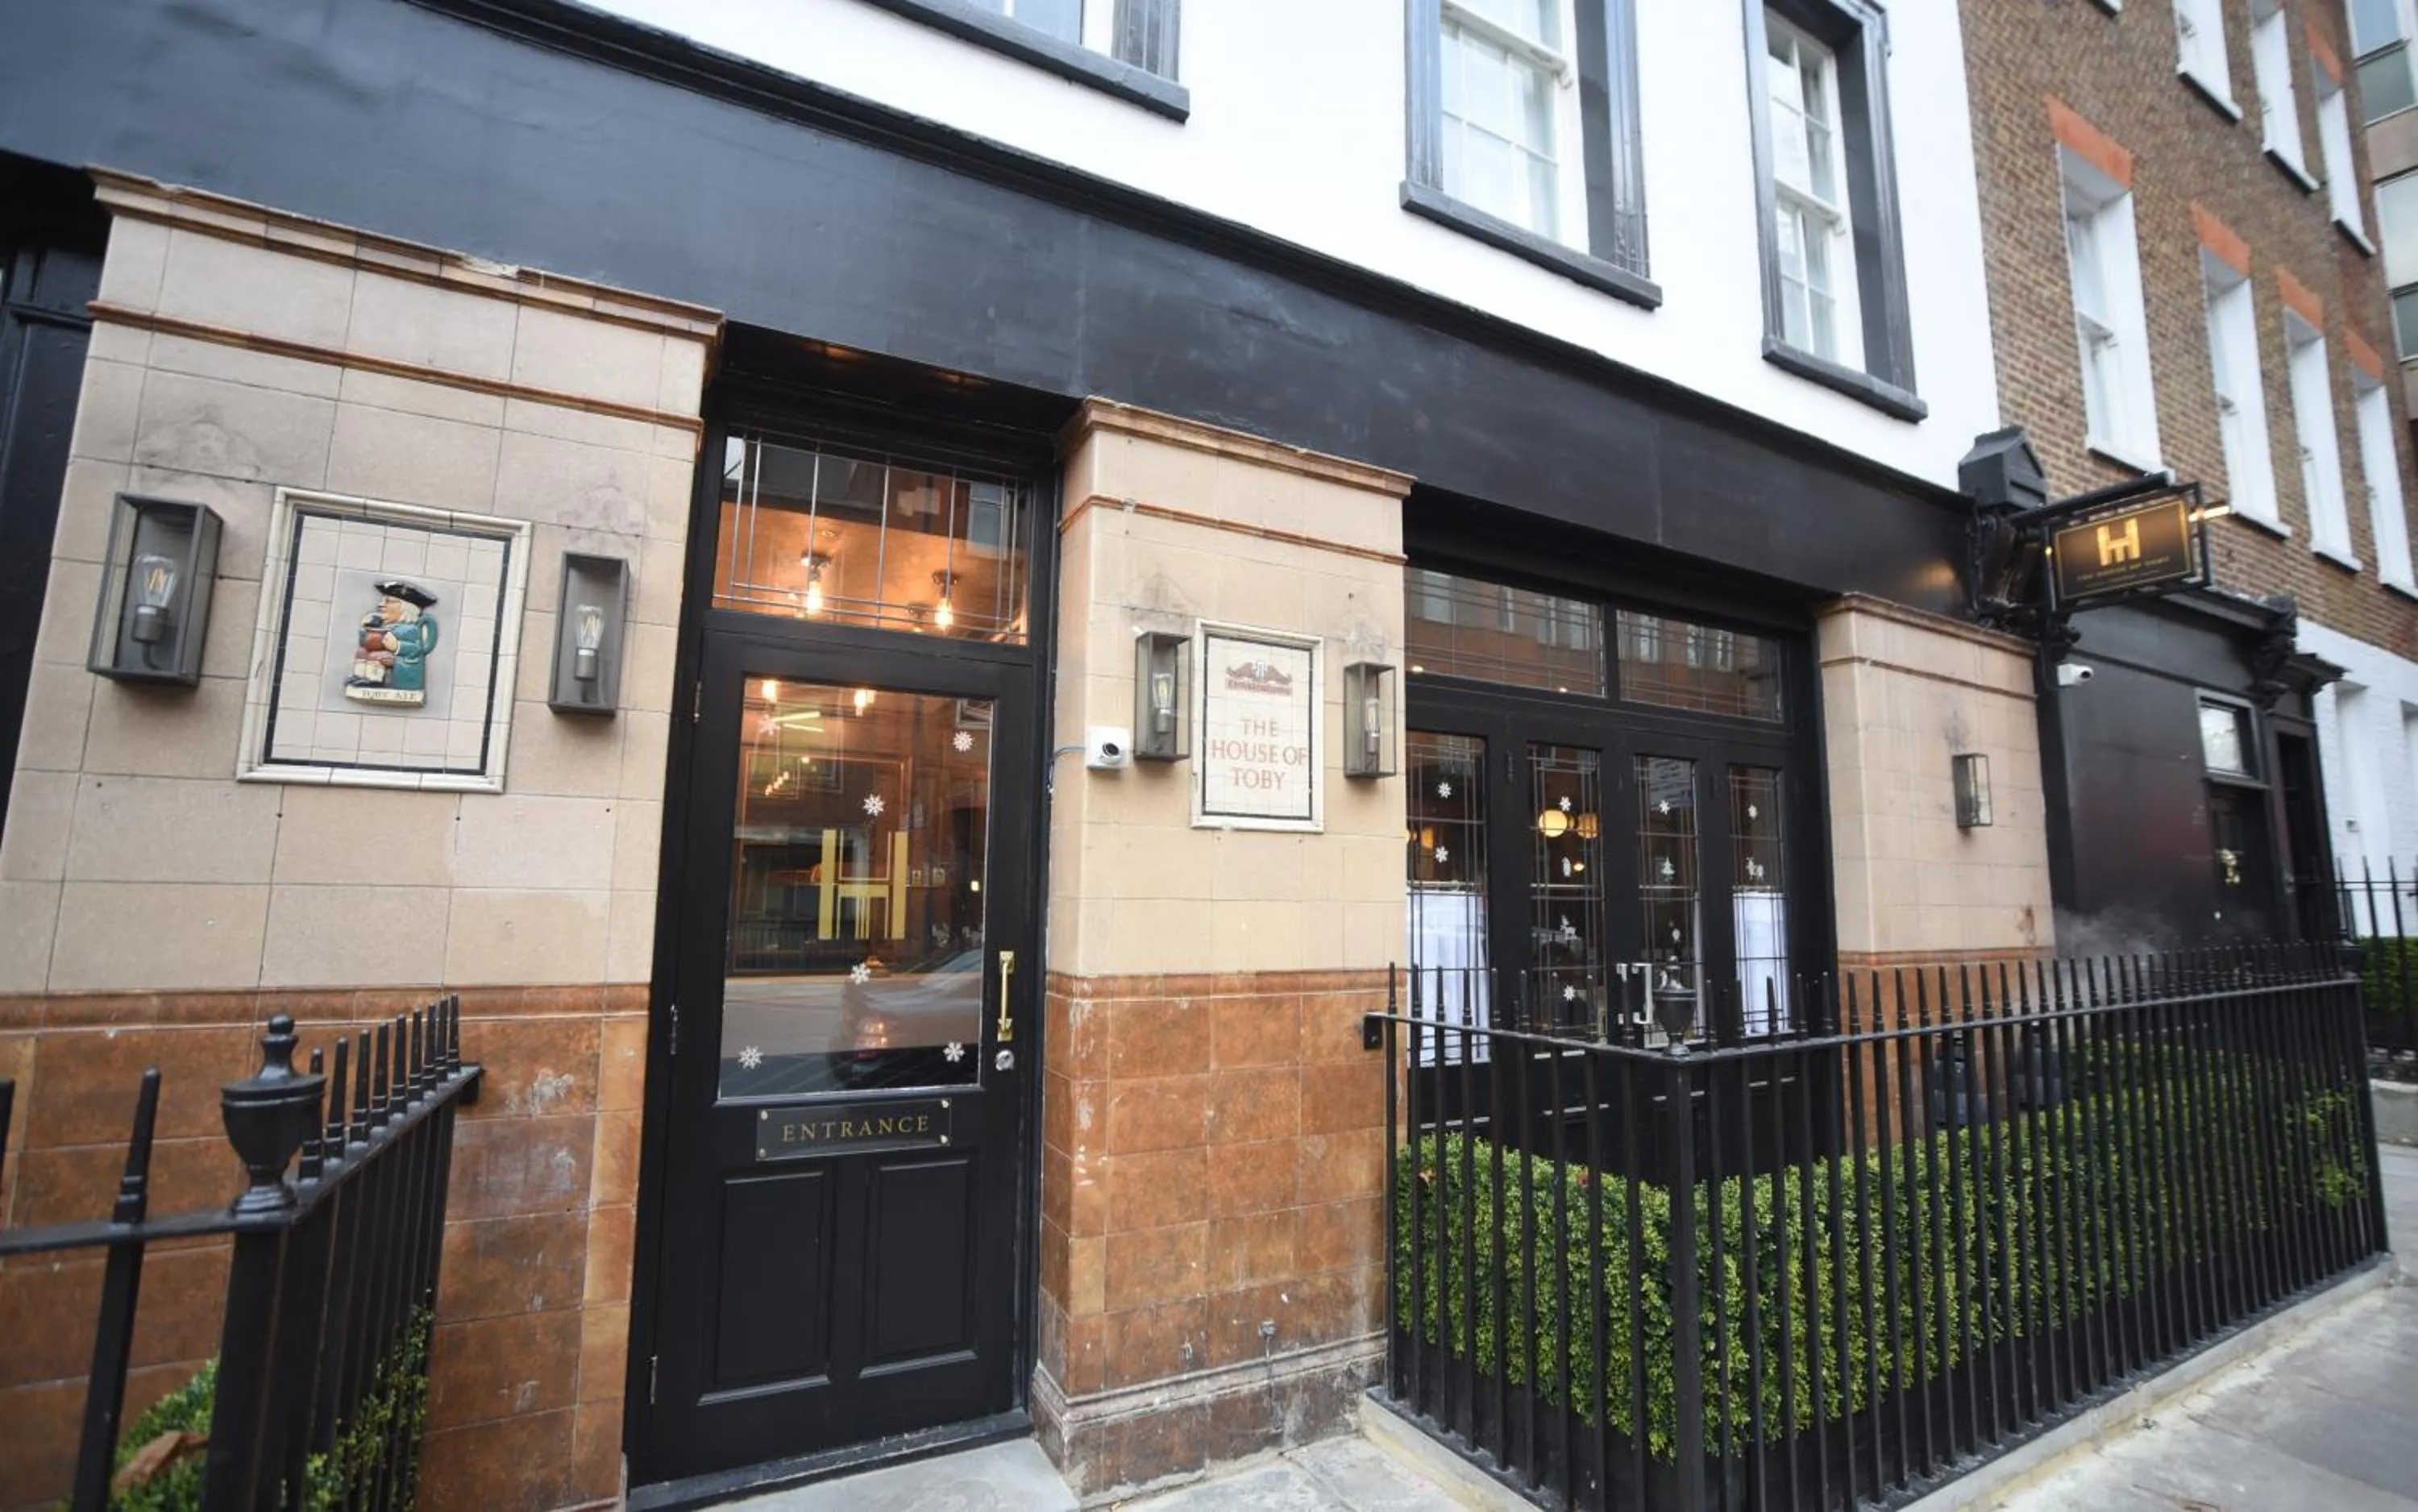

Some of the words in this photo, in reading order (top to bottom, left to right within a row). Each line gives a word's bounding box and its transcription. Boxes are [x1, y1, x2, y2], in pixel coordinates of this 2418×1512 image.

[1240, 719, 1279, 737] THE
[1211, 739, 1279, 764] HOUSE
[1282, 746, 1309, 766] OF
[1232, 767, 1285, 791] TOBY
[783, 1115, 929, 1142] ENTRANCE
